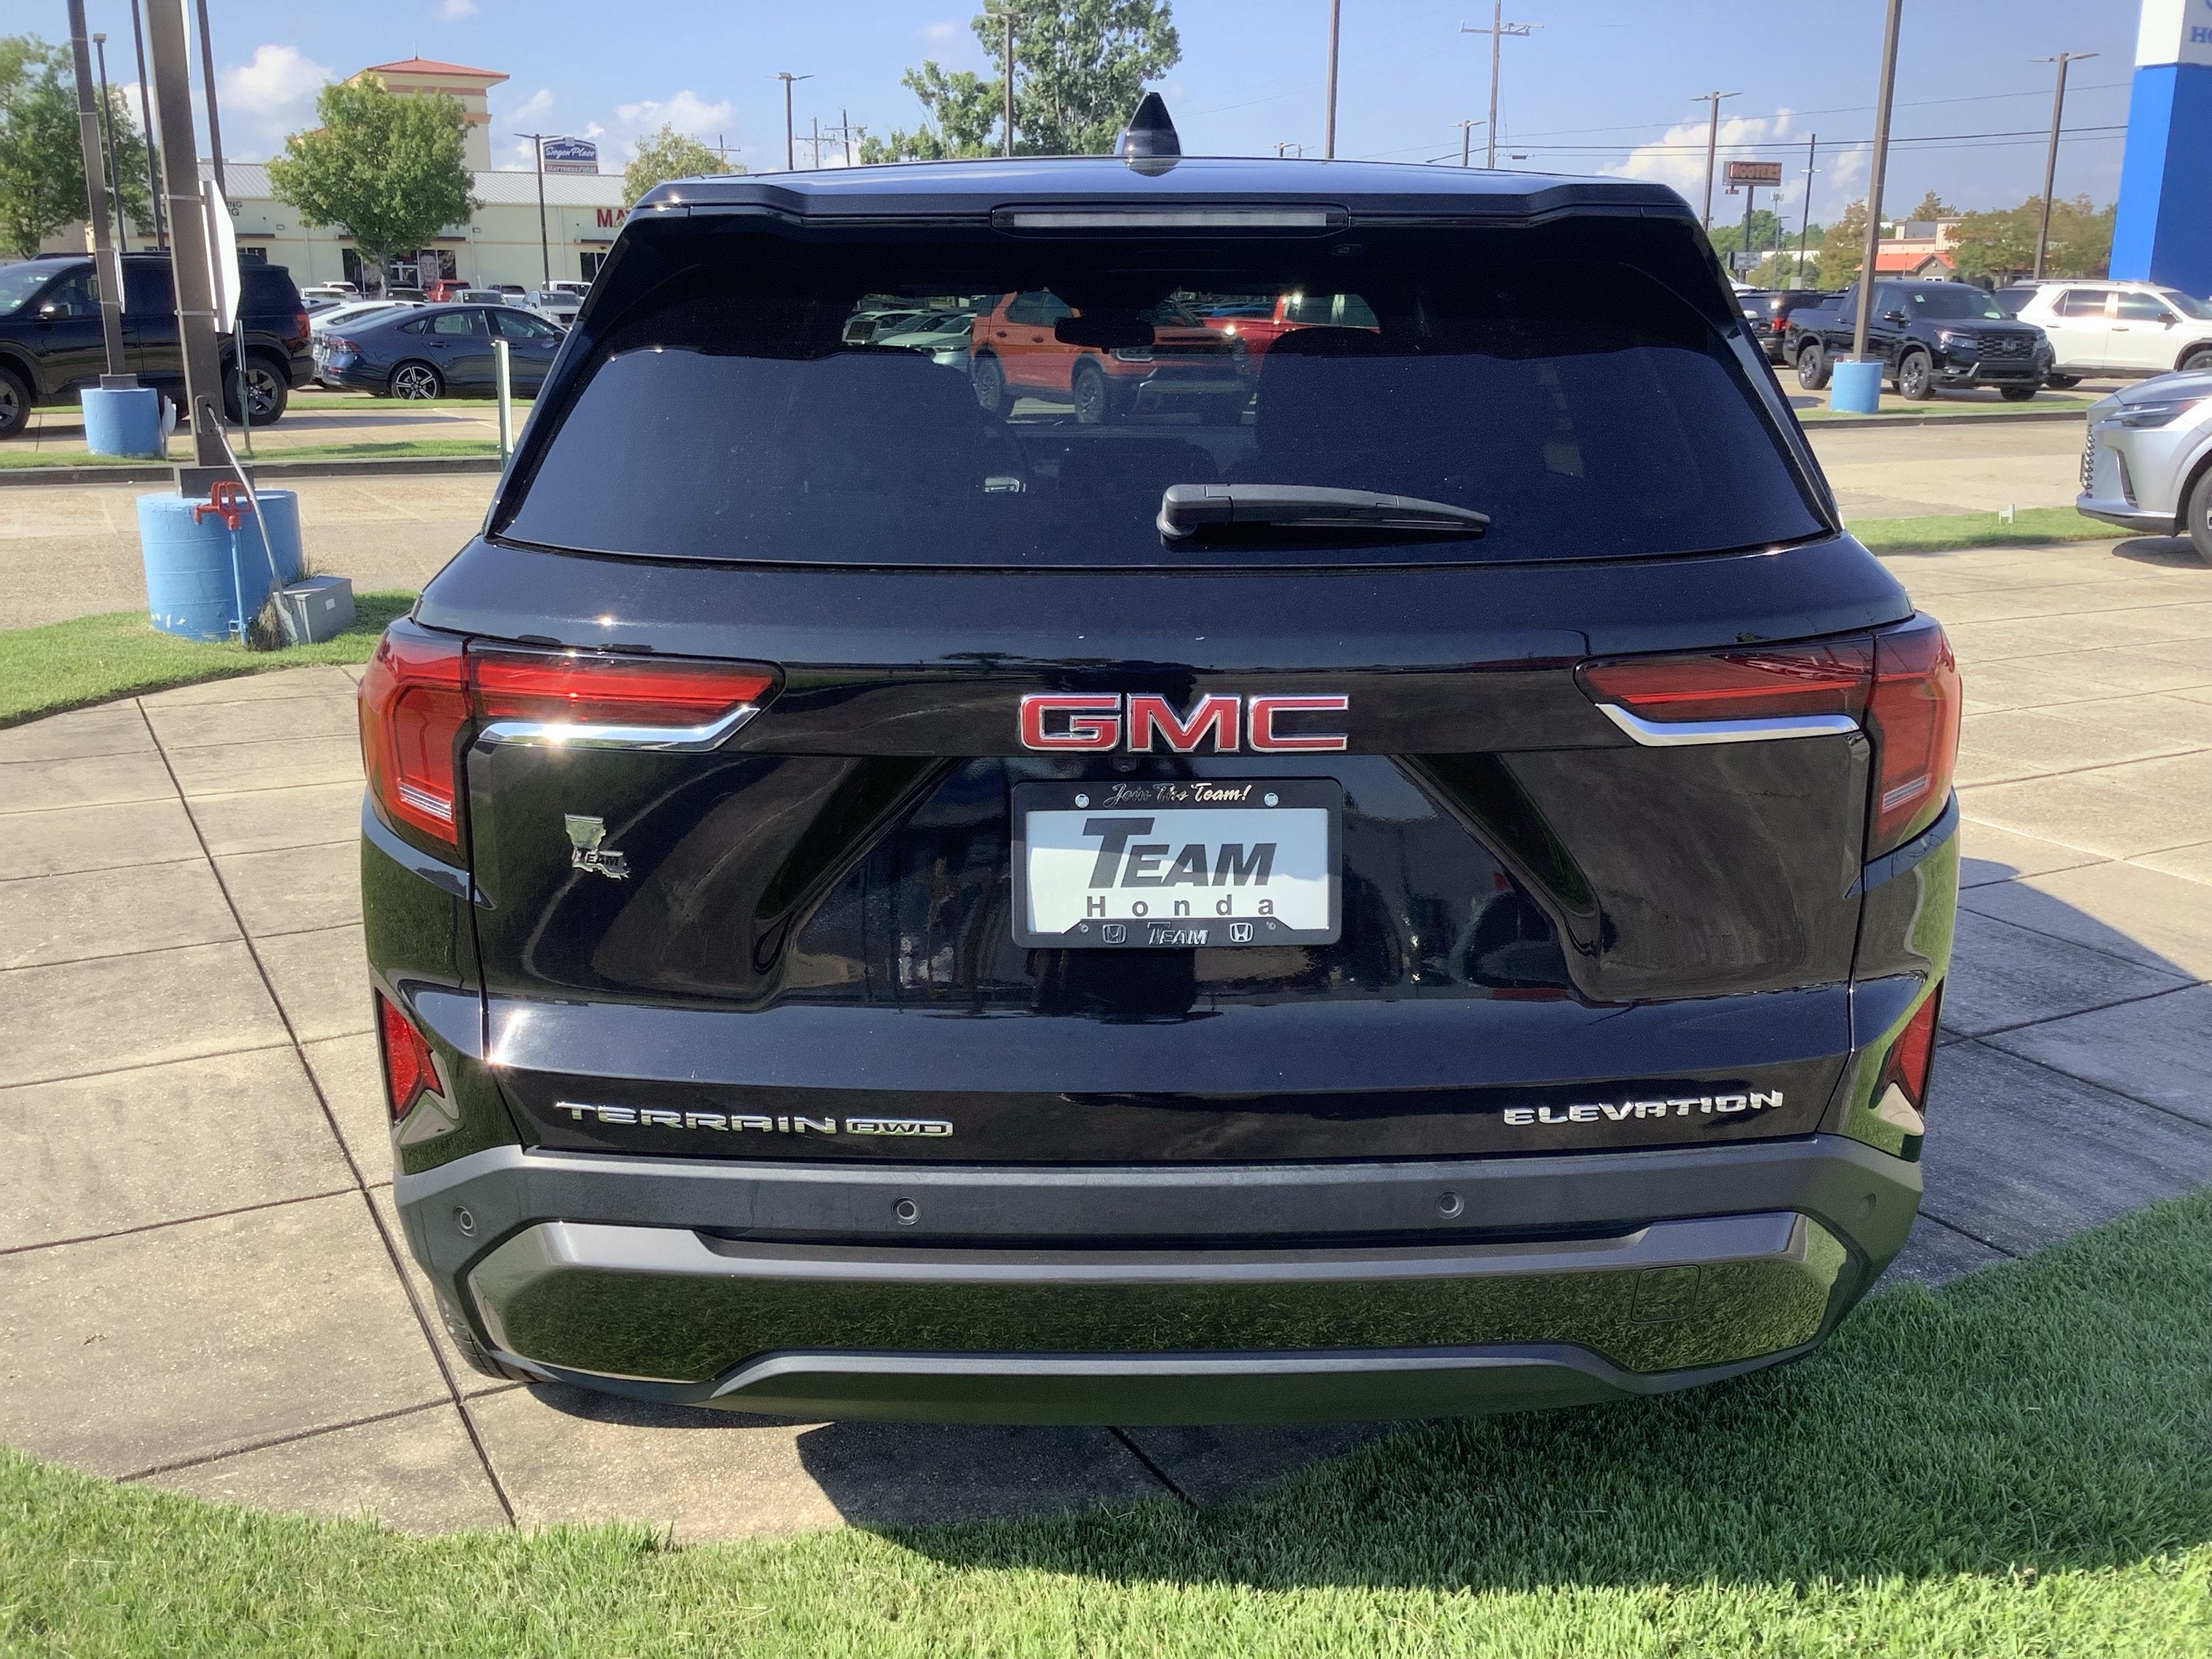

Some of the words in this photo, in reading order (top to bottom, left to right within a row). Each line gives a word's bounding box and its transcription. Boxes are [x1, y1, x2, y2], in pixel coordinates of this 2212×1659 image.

[546, 146, 570, 159] Siegen
[571, 147, 594, 157] Place
[1018, 693, 1349, 753] GMC
[1103, 783, 1151, 808] Join
[1153, 783, 1189, 802] The
[1191, 782, 1252, 802] Team!
[1082, 817, 1277, 888] TEAM
[1086, 895, 1274, 918] Honda
[1147, 922, 1208, 945] TEAM
[556, 1101, 837, 1134] TERRAIN
[846, 1118, 954, 1136] AWD
[1504, 1090, 1784, 1125] ELEVATION
